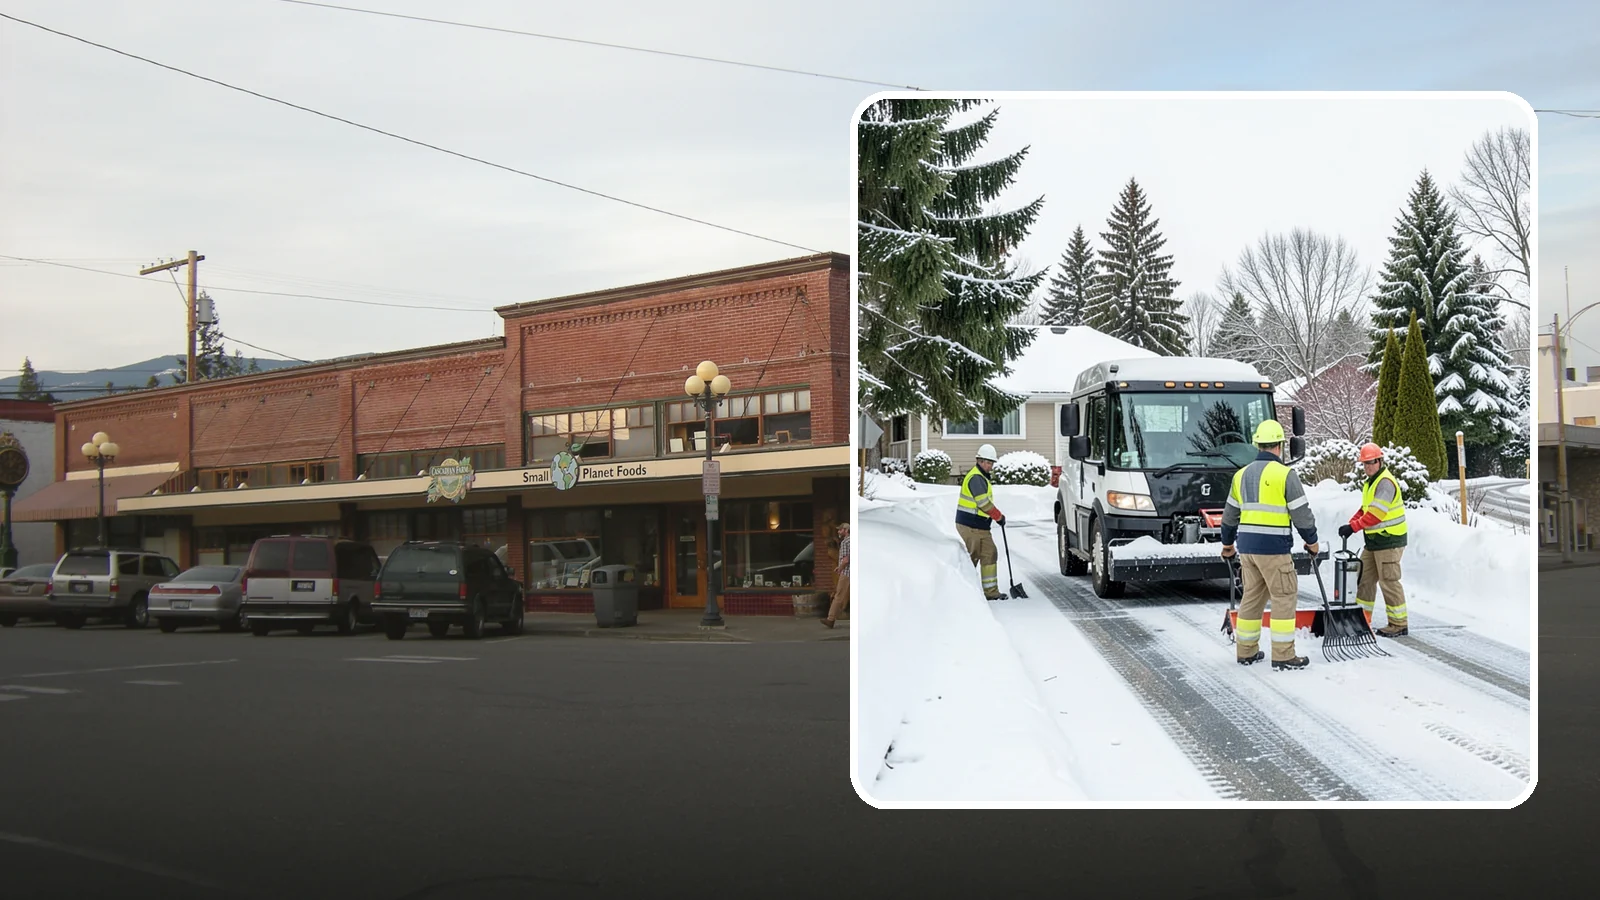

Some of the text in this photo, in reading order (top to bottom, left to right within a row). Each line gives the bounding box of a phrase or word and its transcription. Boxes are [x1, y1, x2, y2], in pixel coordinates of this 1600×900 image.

[523, 463, 647, 483] Small Planet Foods
